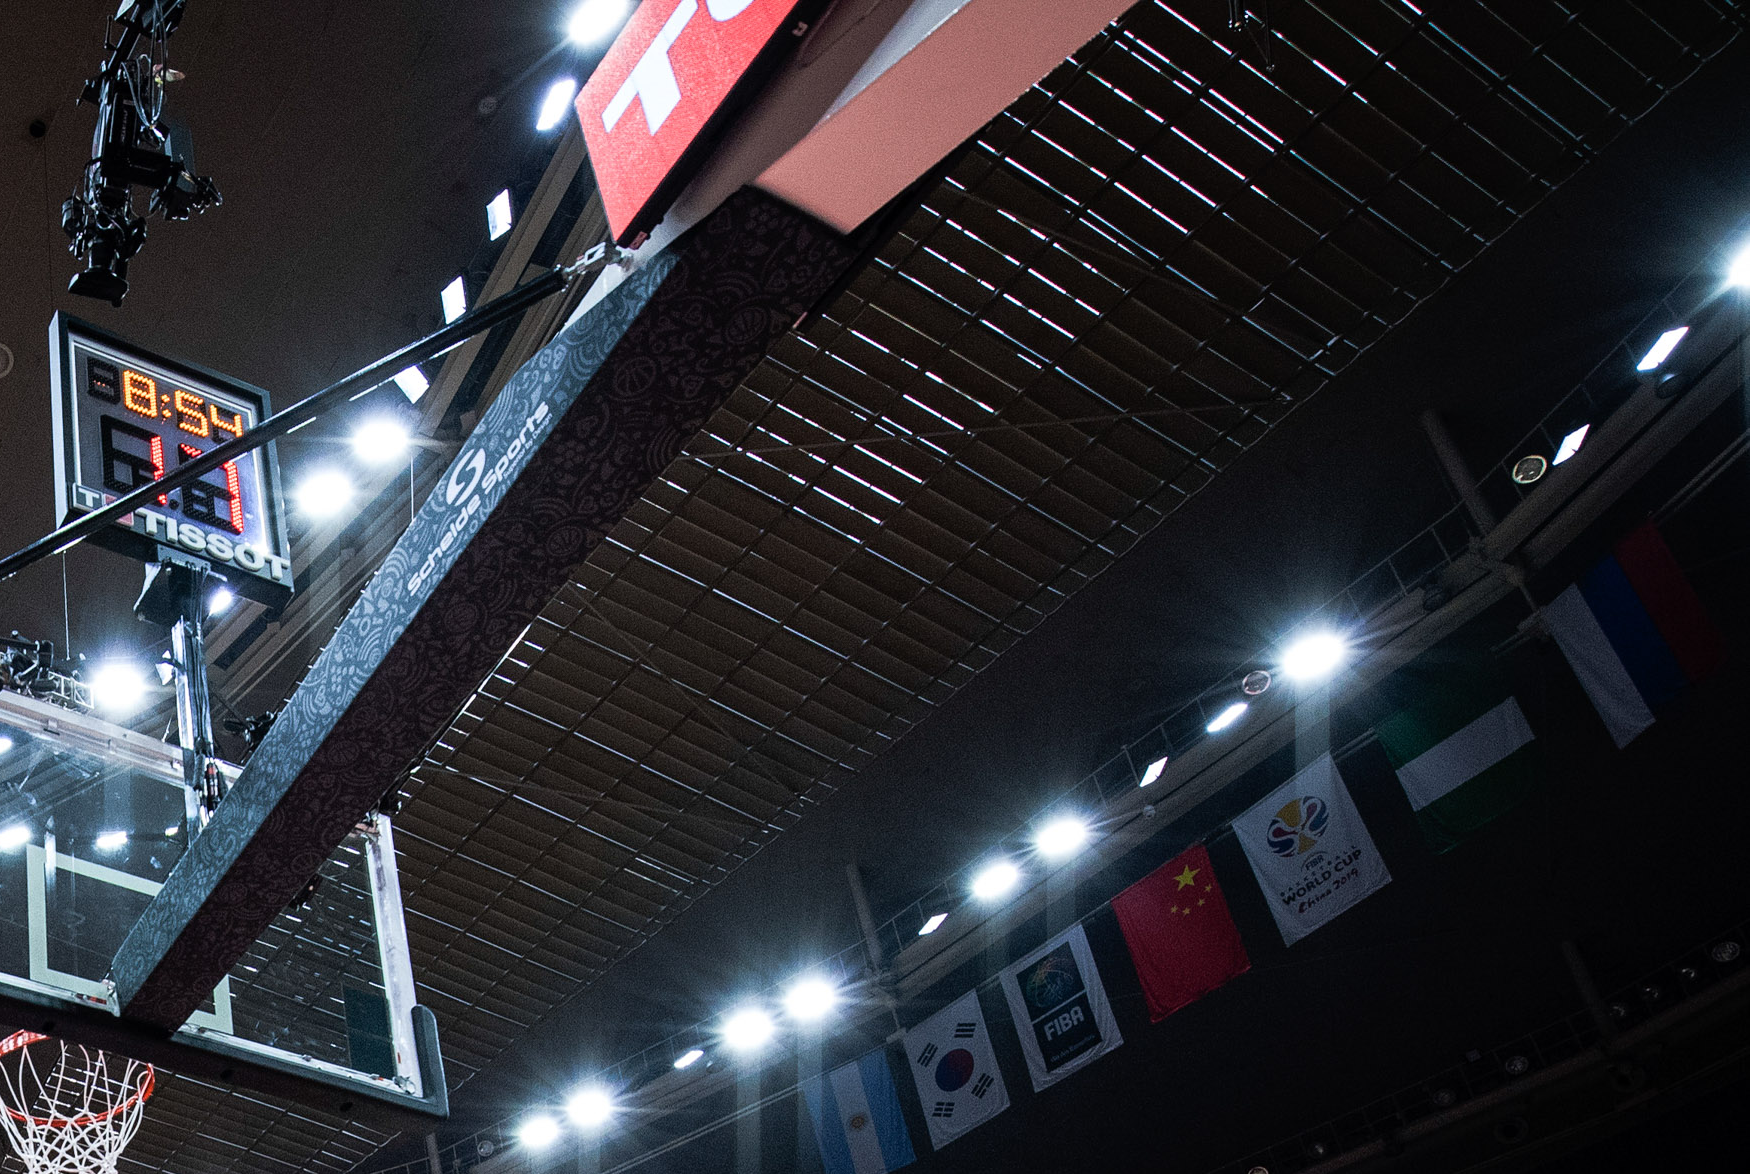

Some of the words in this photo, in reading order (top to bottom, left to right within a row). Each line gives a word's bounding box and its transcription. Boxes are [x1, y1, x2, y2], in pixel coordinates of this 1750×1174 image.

[123, 370, 243, 437] 8:54
[407, 494, 482, 597] Schelde
[481, 401, 549, 495] Sports
[135, 508, 290, 581] TISSOT
[1282, 870, 1332, 905] WORLD
[1334, 849, 1362, 873] CUP
[1298, 889, 1332, 913] China
[1332, 867, 1359, 890] 2019
[1043, 1005, 1086, 1042] FIBA
